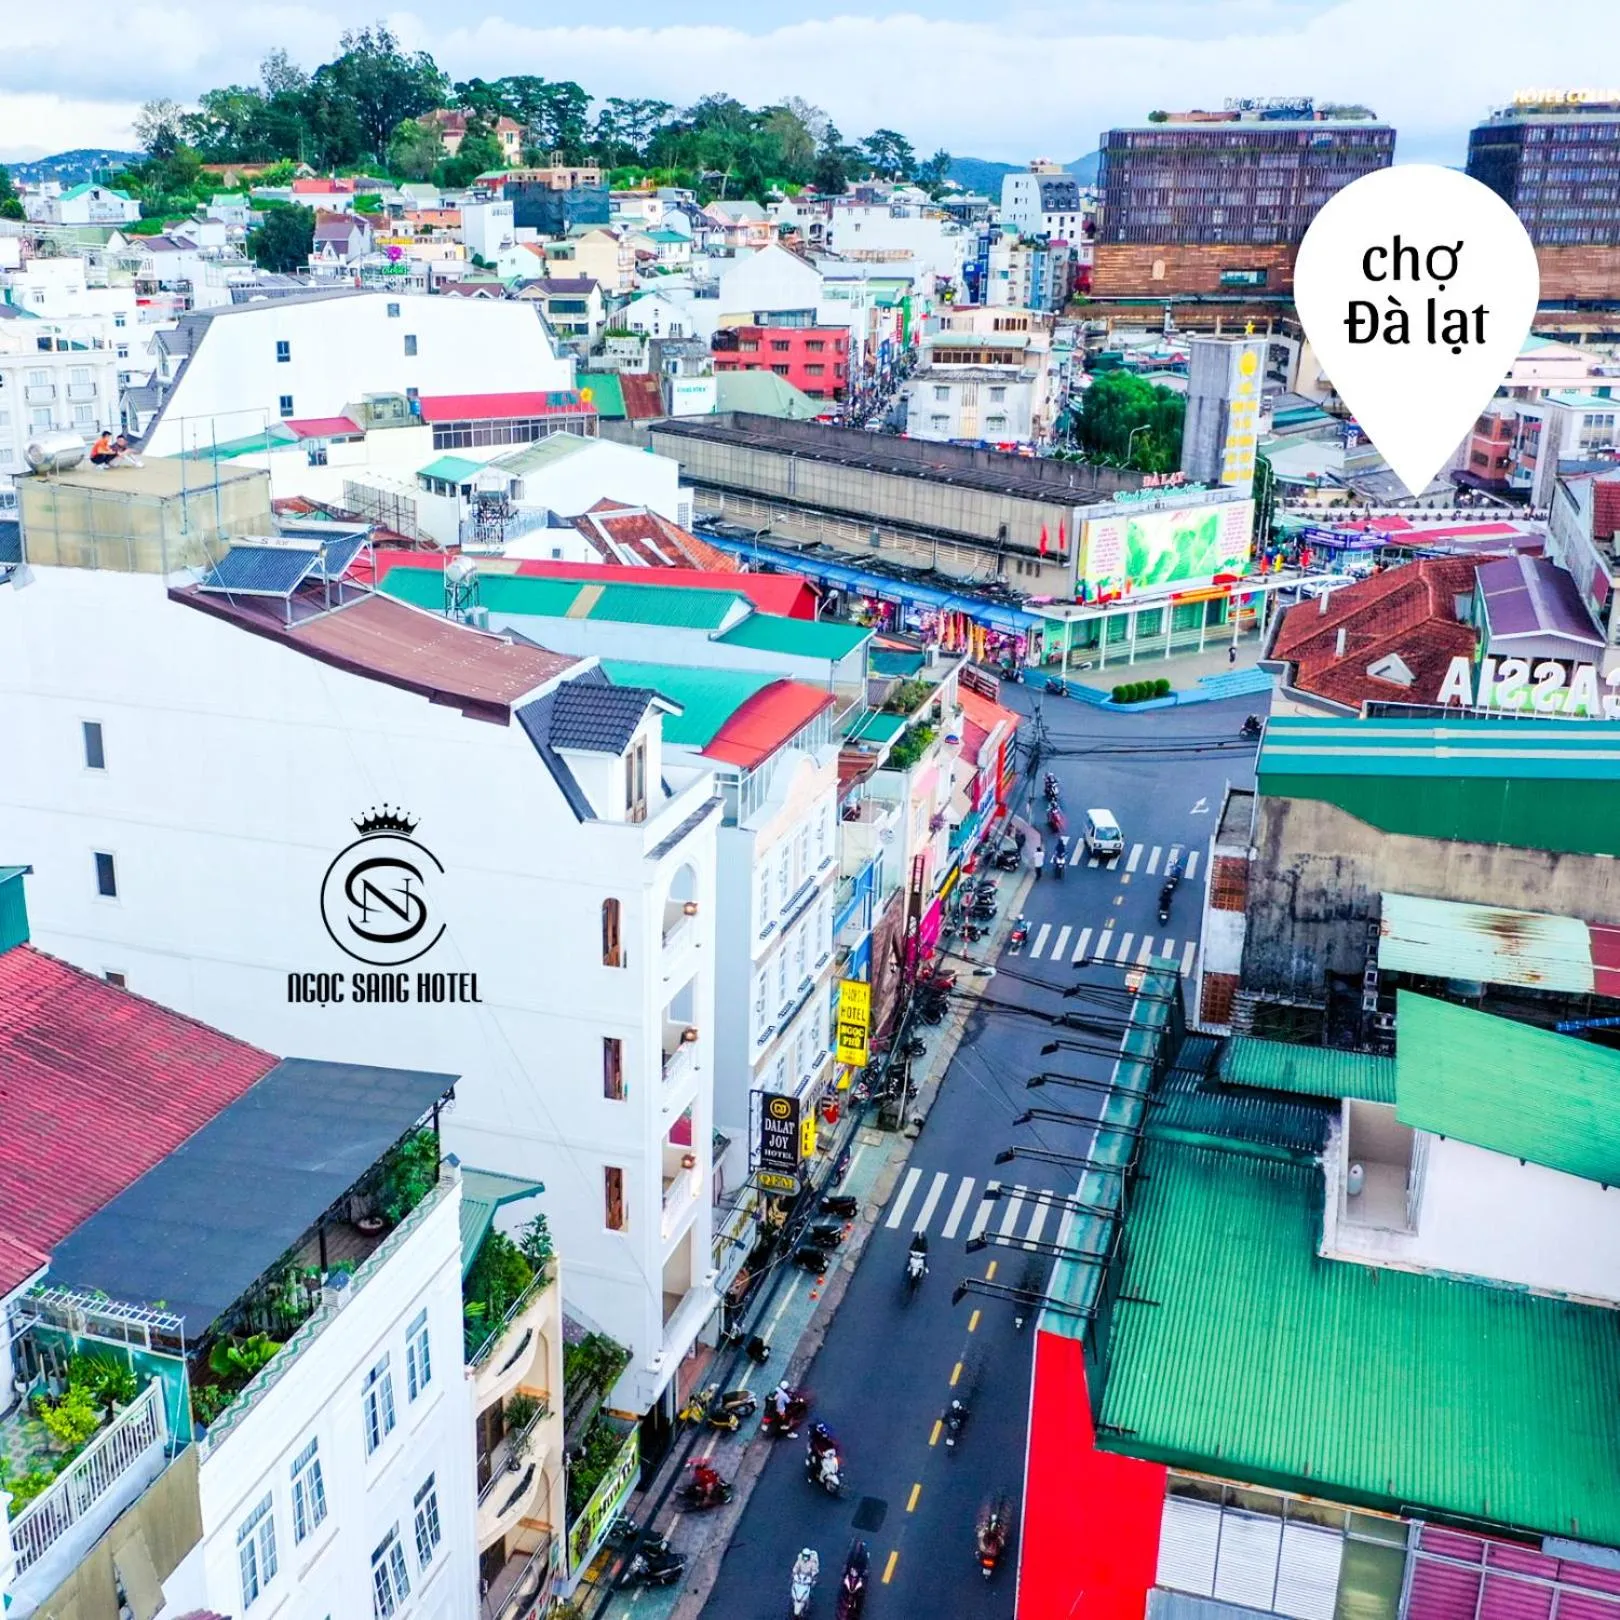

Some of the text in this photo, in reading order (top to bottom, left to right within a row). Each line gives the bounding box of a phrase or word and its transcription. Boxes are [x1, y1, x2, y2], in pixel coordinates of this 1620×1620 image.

[840, 1004, 866, 1023] HOTEL
[764, 1117, 796, 1136] DALAT
[769, 1134, 790, 1150] JOY
[764, 1148, 794, 1161] HOTEL
